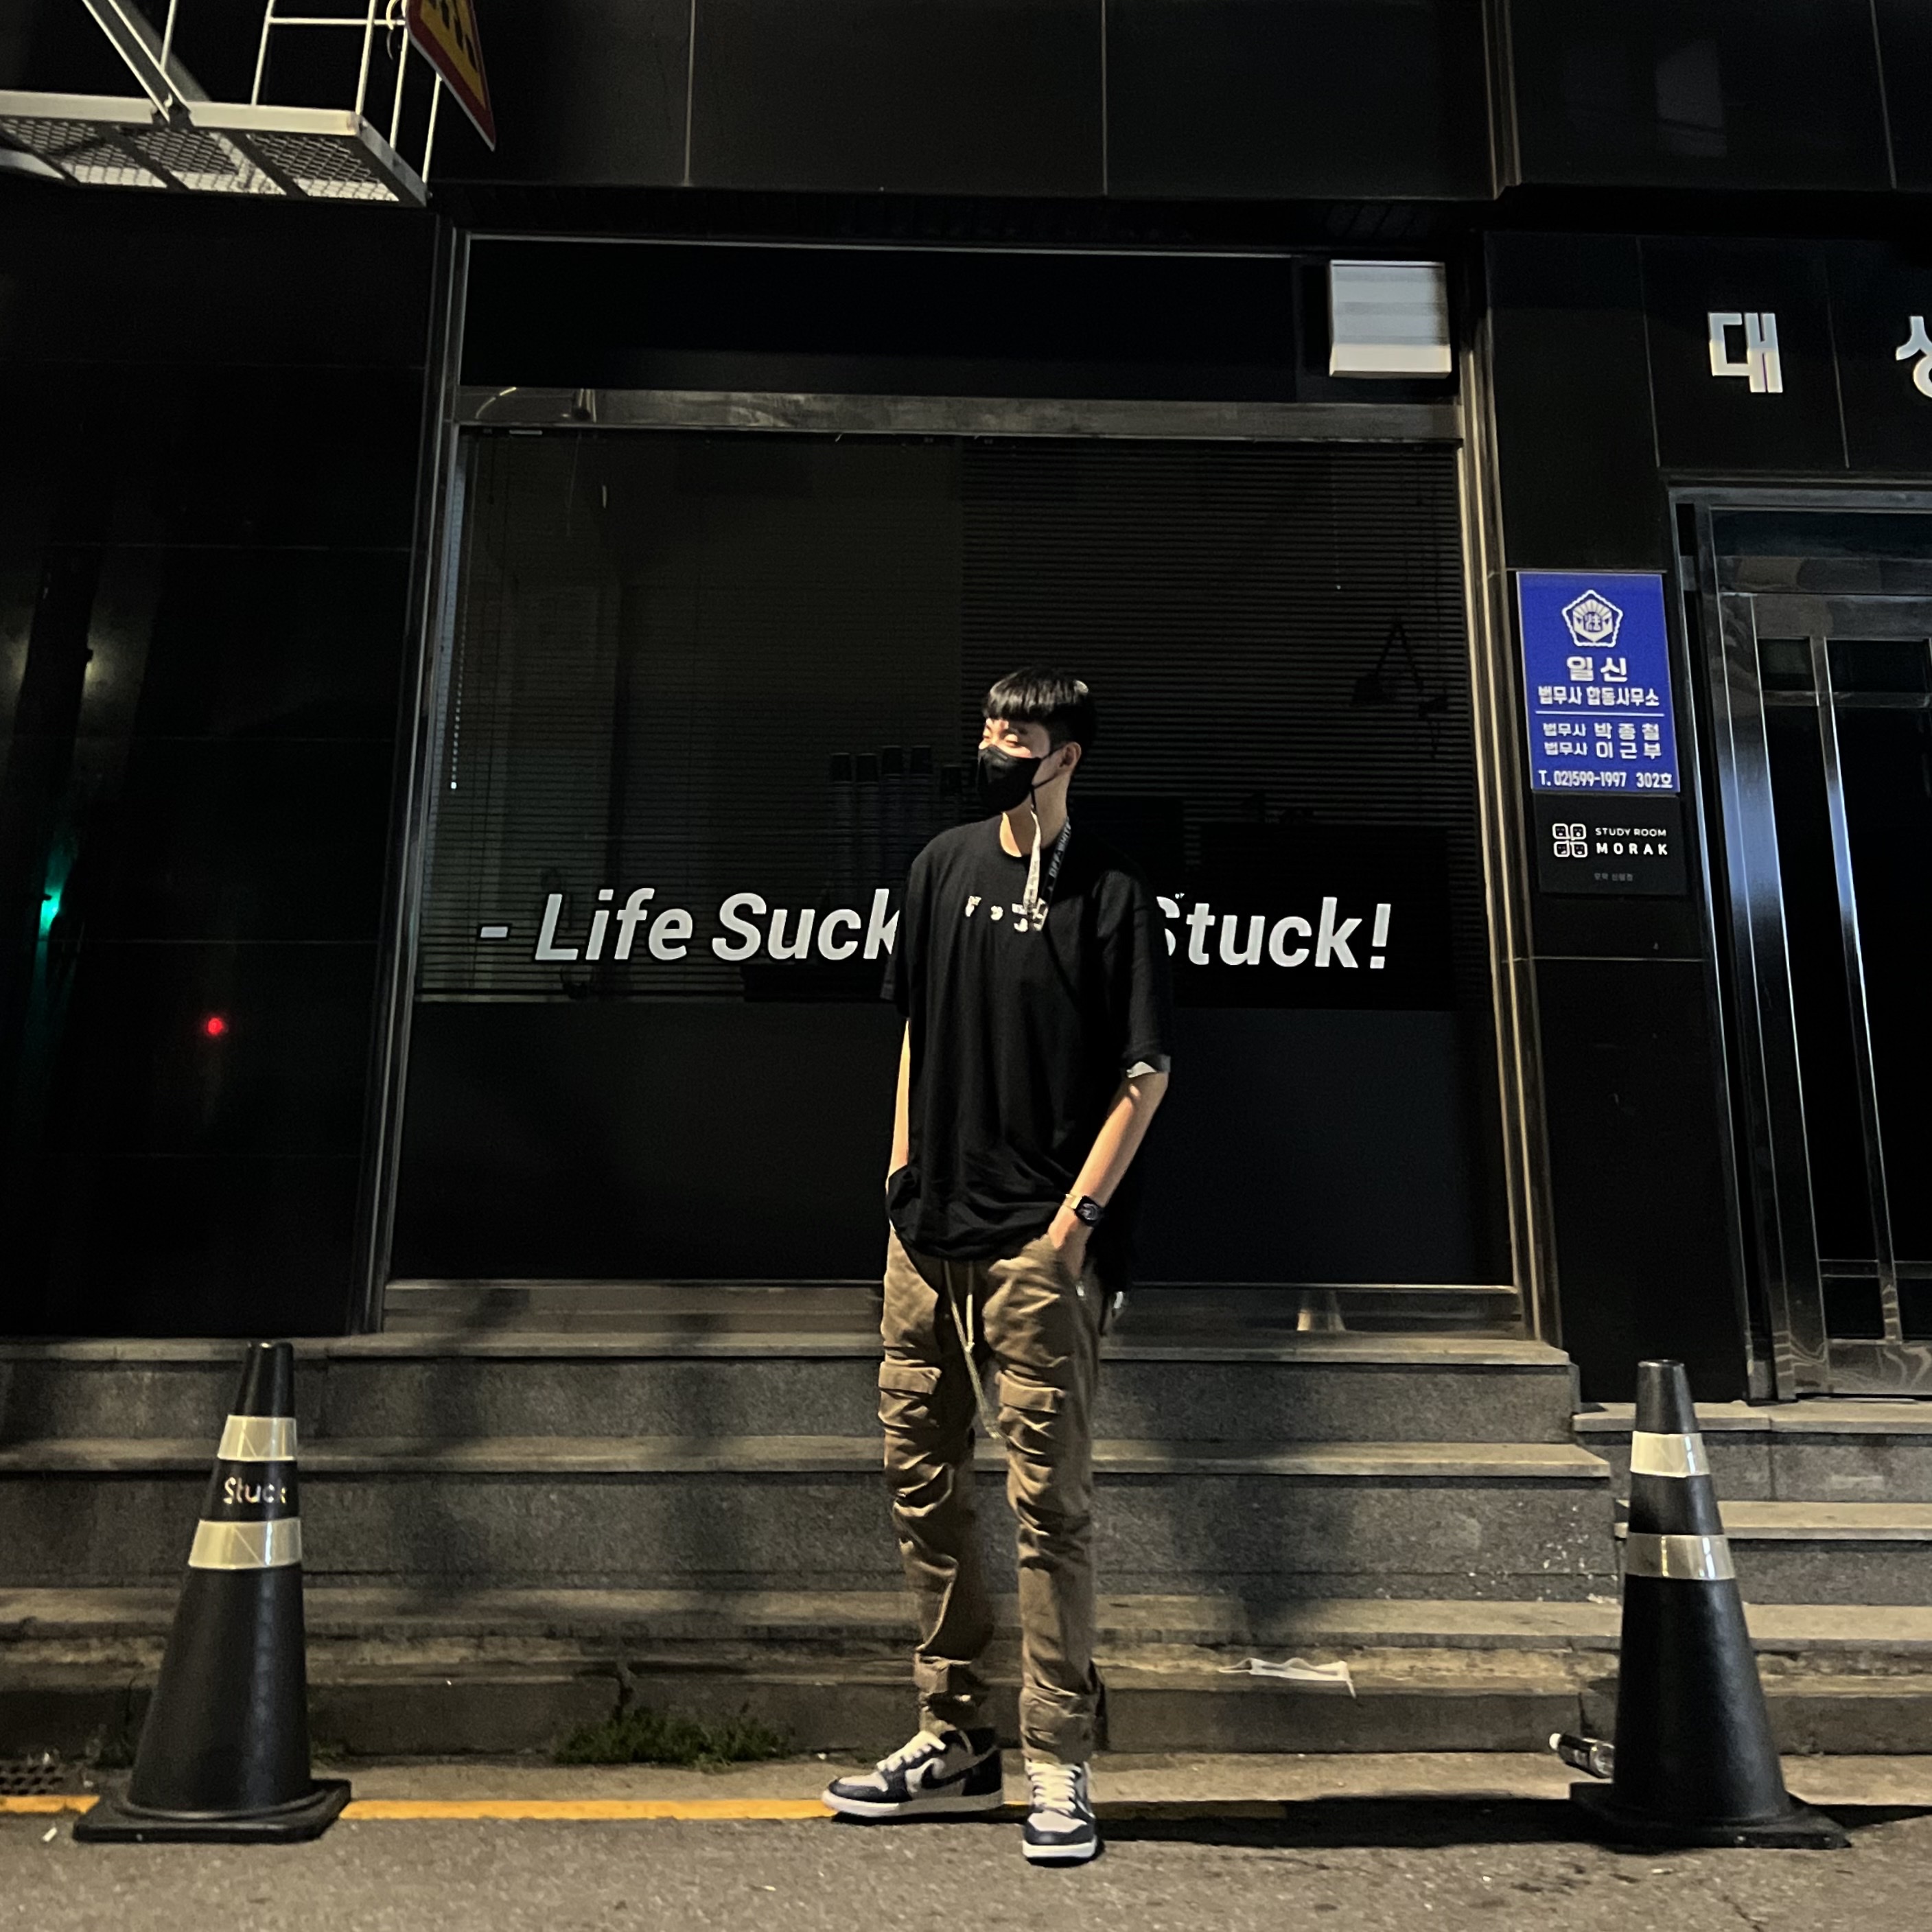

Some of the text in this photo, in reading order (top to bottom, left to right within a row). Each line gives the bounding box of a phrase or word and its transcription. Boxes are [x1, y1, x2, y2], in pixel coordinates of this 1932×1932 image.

[1566, 656, 1628, 682] 일신
[1537, 686, 1660, 706] 법무사 합동사무소
[1543, 723, 1586, 737] 법무사
[1544, 742, 1588, 756] 법무사
[1636, 772, 1673, 789] 302호
[1595, 828, 1666, 837] STUDY ROOM
[1596, 842, 1668, 856] MORAK
[535, 887, 693, 961] Life
